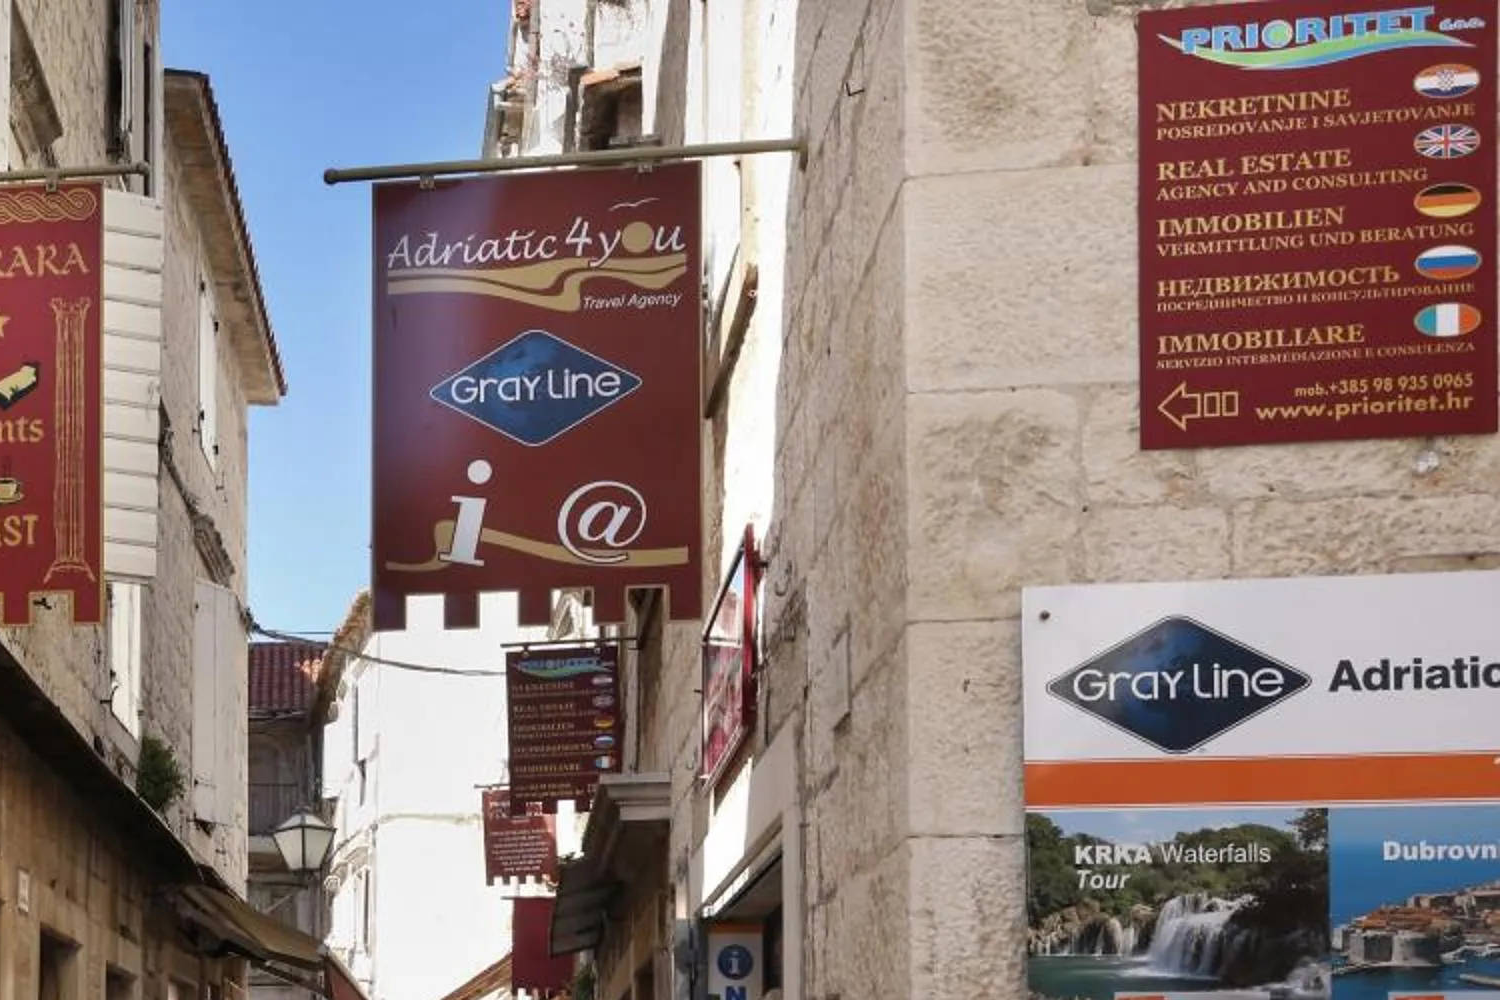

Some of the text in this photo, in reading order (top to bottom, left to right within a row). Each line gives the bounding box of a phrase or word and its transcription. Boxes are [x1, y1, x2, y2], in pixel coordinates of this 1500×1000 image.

[1180, 6, 1435, 54] PRIORITET
[1156, 87, 1352, 122] NEKRETNINE
[1156, 102, 1477, 141] POSREDOVANJE I SAVJETOVANJE
[1156, 149, 1352, 181] REAL ESTATE
[1156, 167, 1429, 201] AGENCY AND CONSULTING
[1156, 206, 1346, 237] IMMOBILIEN
[1156, 222, 1475, 257] VERMITTLUNG UND BERATUNG
[1156, 264, 1401, 298] НЕДВИЖИМОСТЬ
[582, 291, 682, 310] Travel Agency
[1156, 323, 1366, 355] IMMOBILIARE
[1156, 355, 1224, 370] SERVIZIO
[1226, 346, 1361, 365] INTERMEDIAZIONE
[1377, 341, 1476, 357] CONSULENZA
[451, 366, 621, 404] Gray Line
[1373, 376, 1394, 393] 98
[1398, 374, 1429, 391] 935
[1432, 371, 1474, 389] 0965
[1254, 390, 1474, 422] www.prioritet.hr
[1072, 662, 1285, 701] Gray Line
[1074, 842, 1272, 866] KRKA Waterfalls
[1076, 868, 1130, 890] Tour
